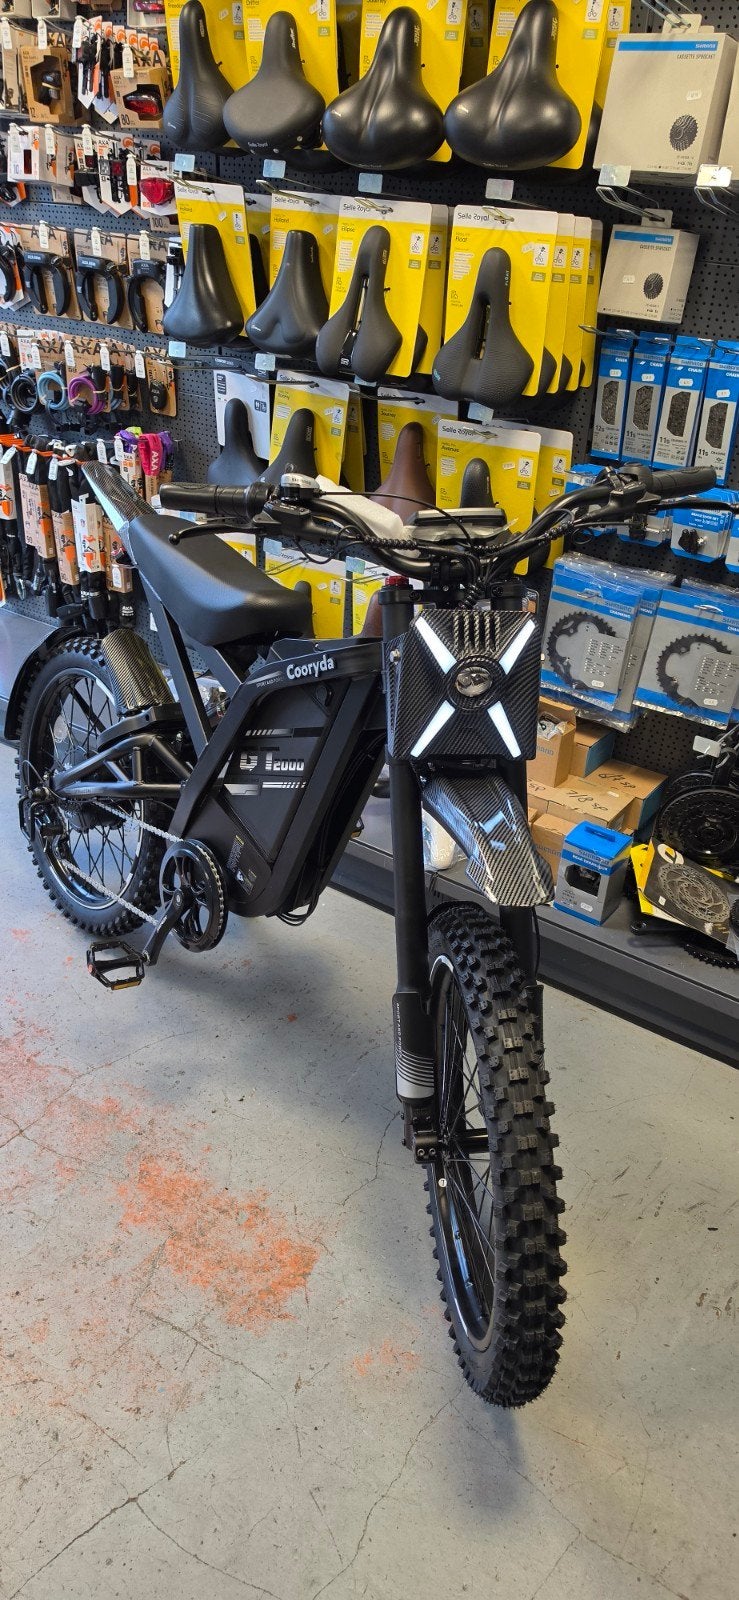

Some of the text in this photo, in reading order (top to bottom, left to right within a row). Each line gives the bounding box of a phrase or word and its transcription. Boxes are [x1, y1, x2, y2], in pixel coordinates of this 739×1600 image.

[343, 203, 356, 212] Selle
[457, 212, 471, 221] Selle
[455, 235, 468, 243] Float
[441, 425, 457, 434] Selle
[286, 654, 335, 680] Cooryda
[273, 758, 305, 771] 2000
